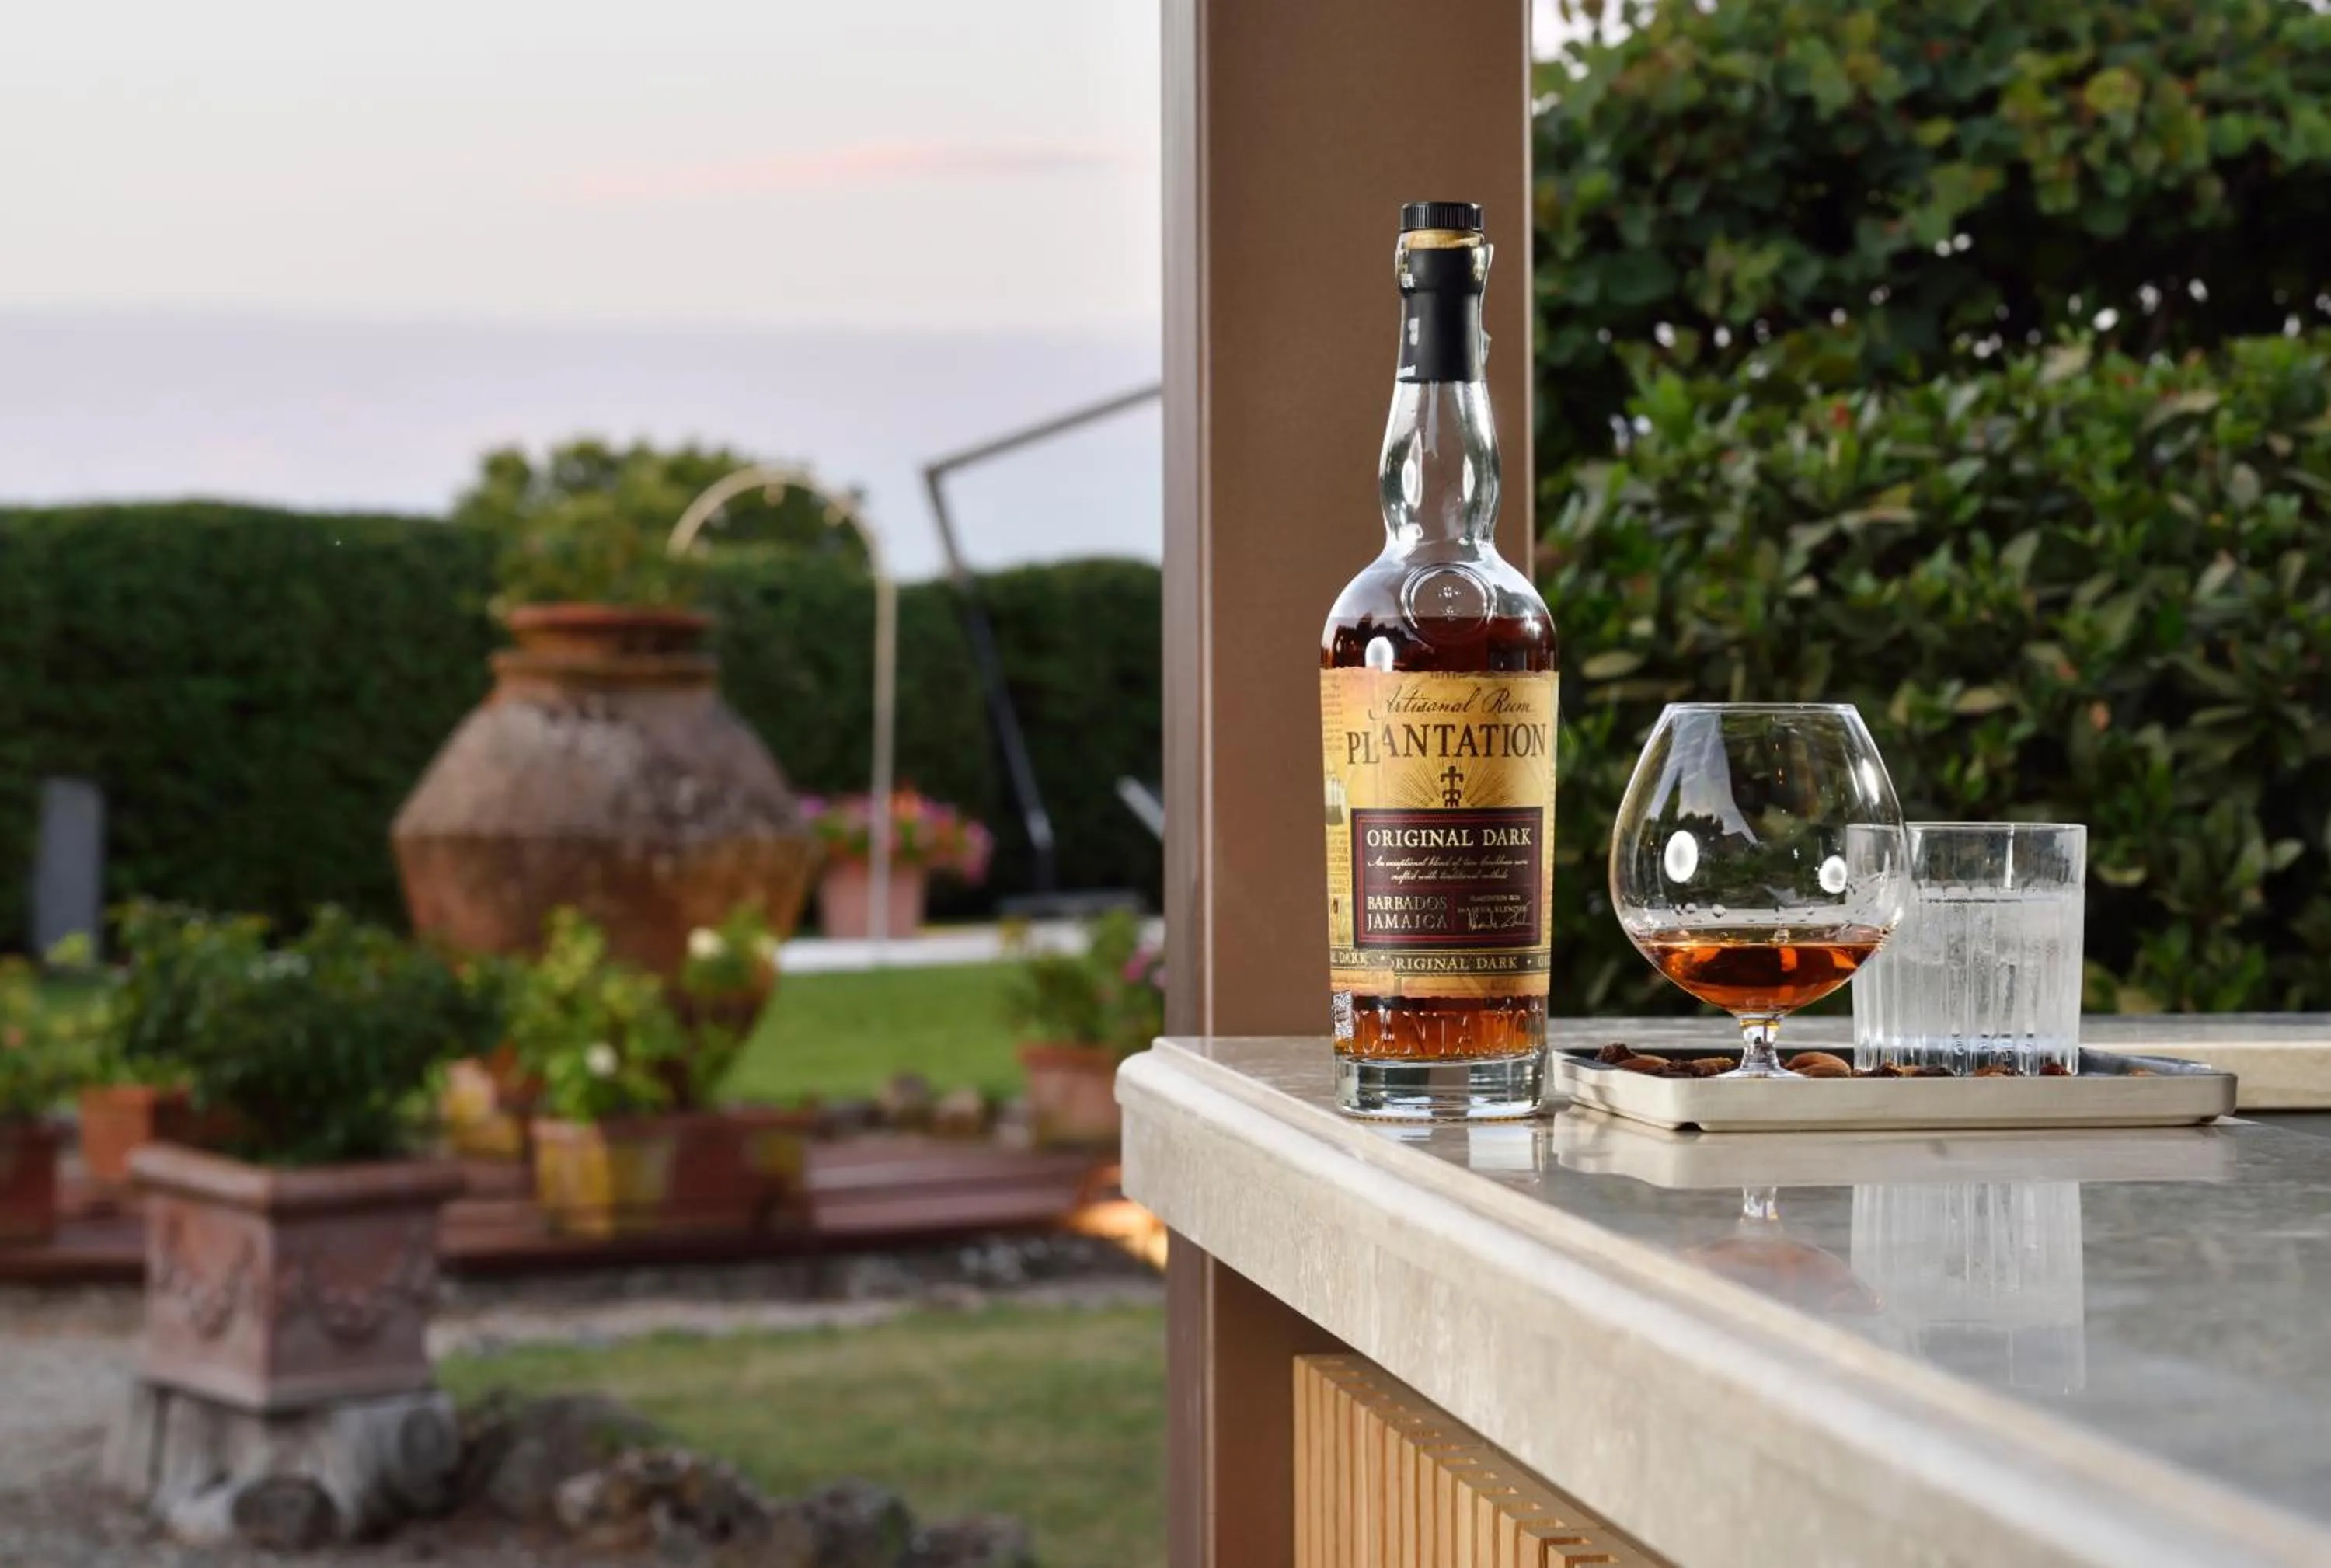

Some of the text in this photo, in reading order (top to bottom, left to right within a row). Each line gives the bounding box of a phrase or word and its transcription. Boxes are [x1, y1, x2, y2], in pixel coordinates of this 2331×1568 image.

[1368, 683, 1480, 721] Artisanal
[1482, 686, 1537, 716] Rum
[1346, 723, 1546, 765] PLANTATION
[1366, 828, 1532, 848] ORIGINAL DARK
[1367, 894, 1448, 911] BARBADOS
[1366, 913, 1448, 932] JAMAICA
[1391, 956, 1469, 971] RIGINAL
[1476, 956, 1518, 970] DARK
